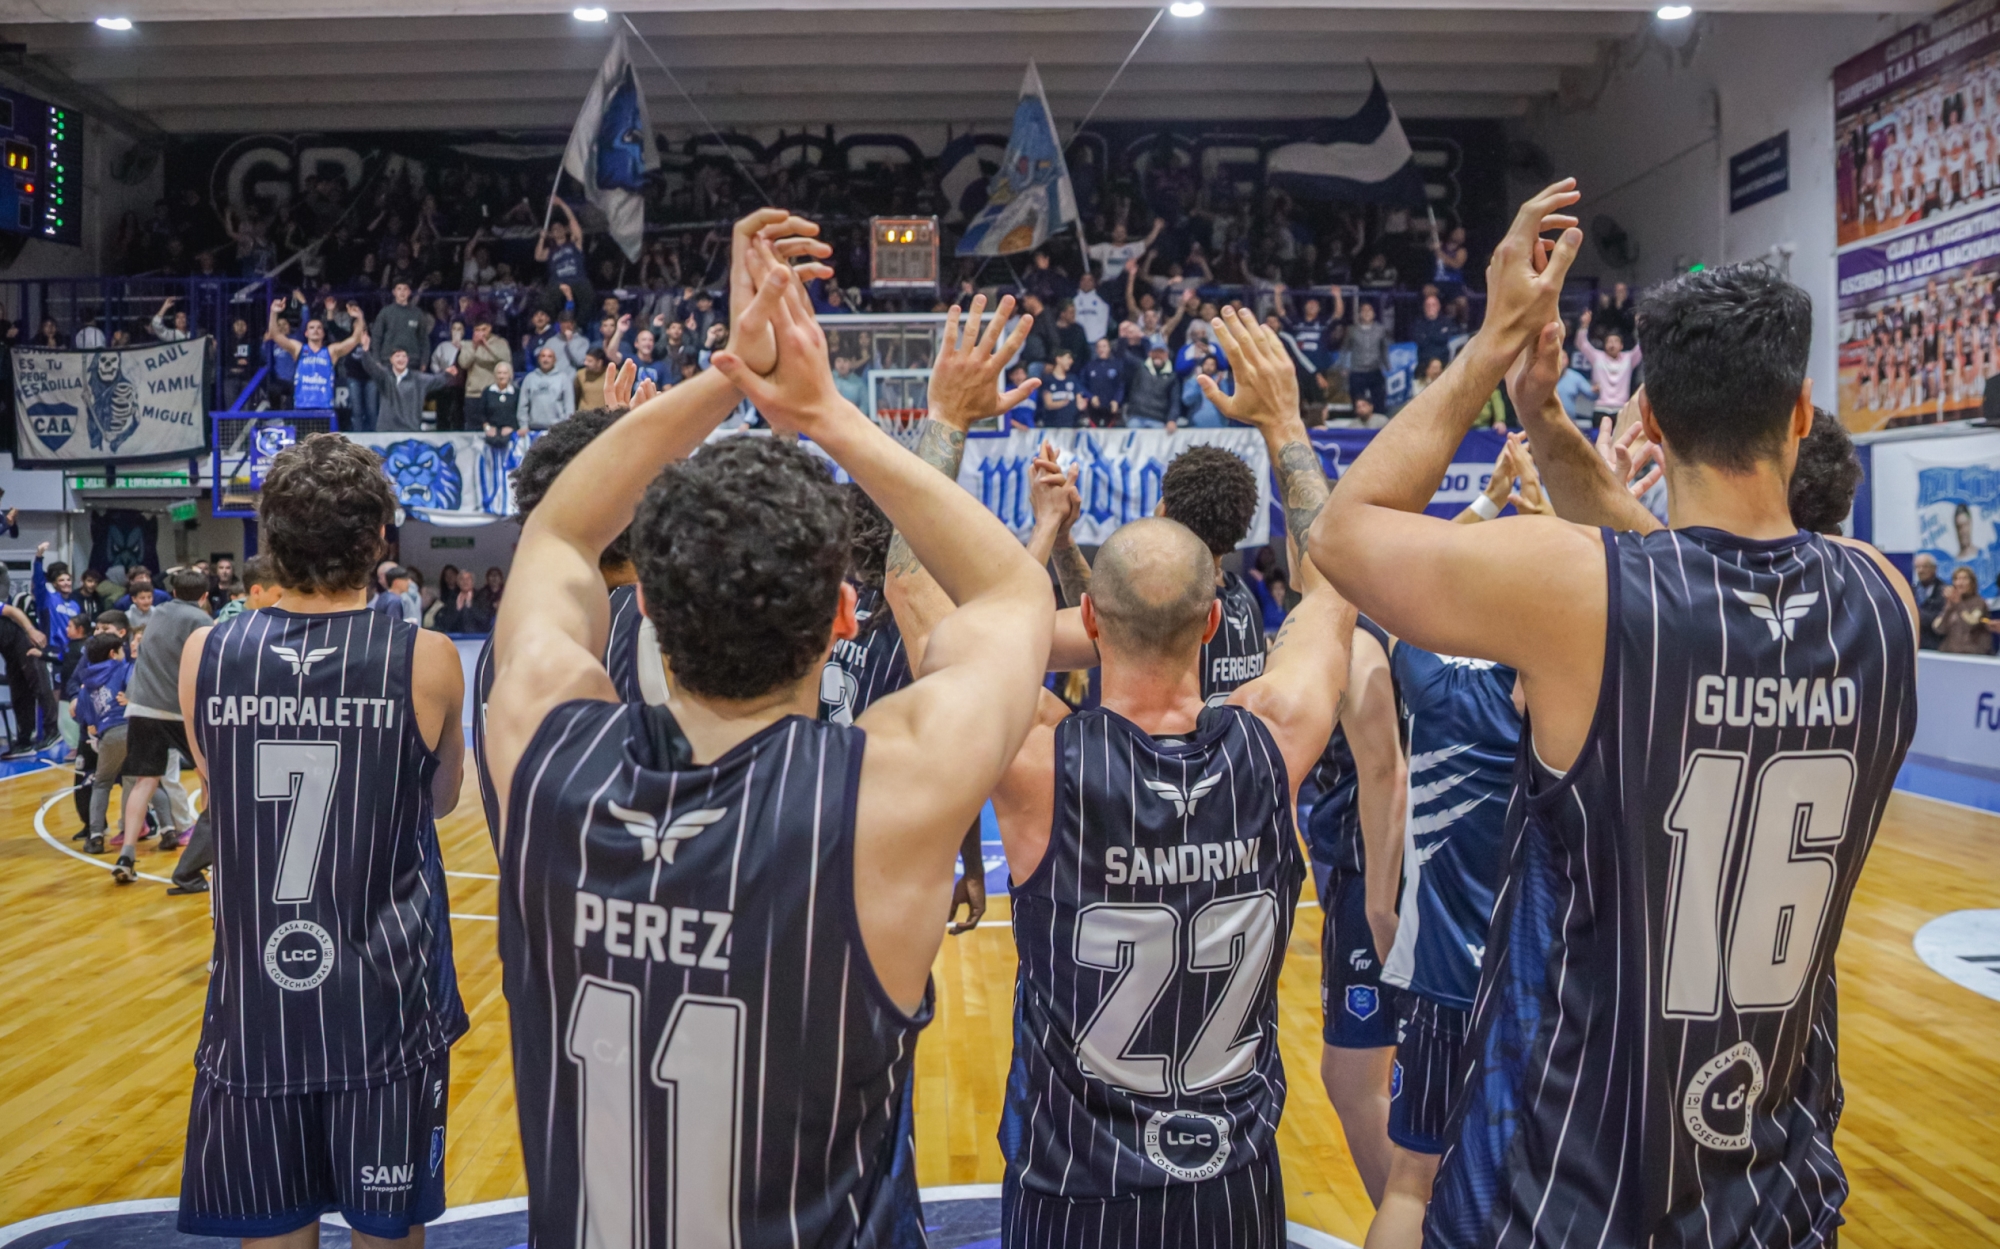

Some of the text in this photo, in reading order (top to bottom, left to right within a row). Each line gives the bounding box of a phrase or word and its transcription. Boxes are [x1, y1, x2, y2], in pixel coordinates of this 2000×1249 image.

[1895, 260, 1913, 282] LA
[1913, 252, 1942, 277] LIGA
[19, 358, 35, 370] ES
[144, 345, 188, 371] RAUL
[20, 372, 48, 383] PEOR
[147, 375, 199, 395] YAMIL
[34, 417, 72, 434] CAA
[142, 405, 194, 426] MIGUEL
[207, 695, 395, 728] CAPORALETTI
[254, 739, 341, 905] 7
[1105, 836, 1261, 885] SANDRINI
[1662, 748, 1858, 1021] 16
[270, 923, 329, 947] LA CASA DE LAS
[573, 890, 733, 970] PEREZ
[282, 949, 317, 962] LCC
[270, 964, 329, 989] COSECHADORAS
[1072, 888, 1280, 1097] 22
[1696, 1070, 1713, 1086] LA
[565, 973, 748, 1249] 11
[1687, 1096, 1700, 1106] 19
[1146, 1134, 1157, 1143] 19
[1167, 1131, 1212, 1147] LCC
[1152, 1150, 1226, 1179] COSECHADORAS
